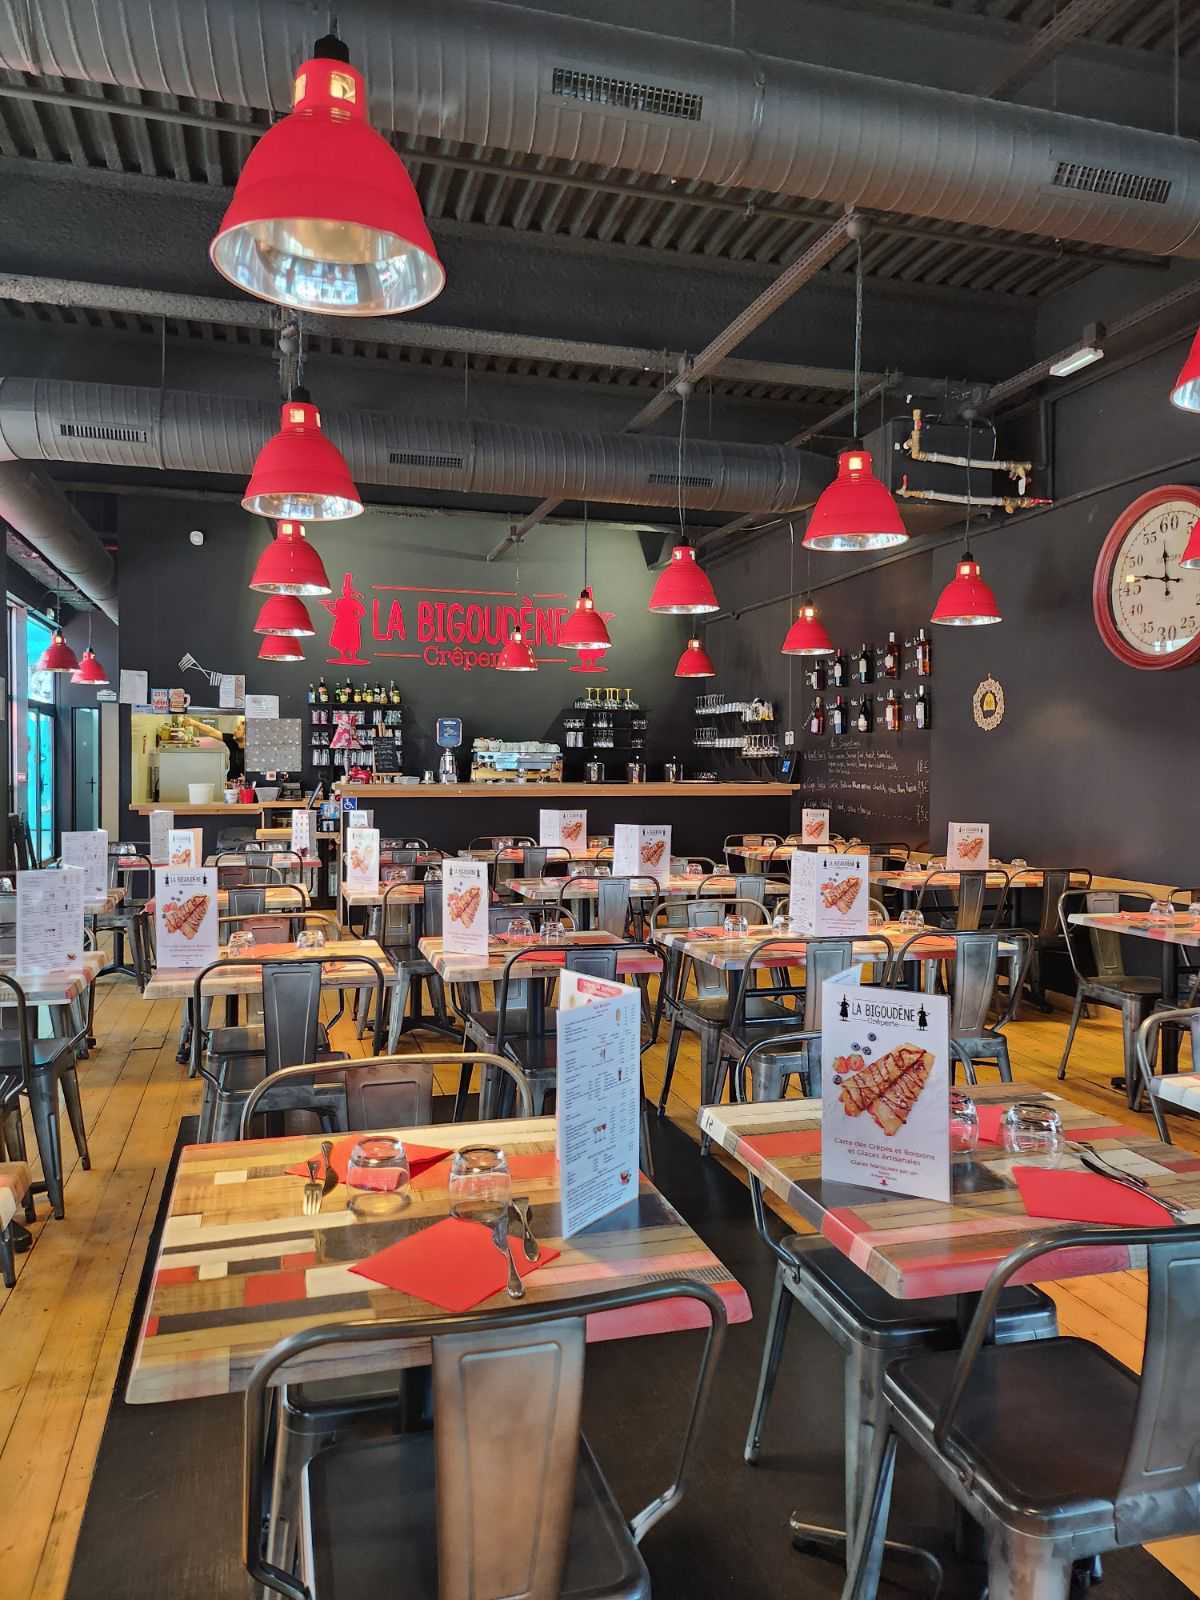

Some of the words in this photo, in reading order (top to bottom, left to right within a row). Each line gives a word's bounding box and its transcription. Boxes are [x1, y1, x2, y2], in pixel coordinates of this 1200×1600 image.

[1160, 514, 1179, 534] 60
[1143, 531, 1157, 545] 55
[1129, 553, 1144, 568] 50
[372, 598, 406, 641] LA
[1180, 615, 1196, 629] 25
[1157, 625, 1177, 642] 30
[852, 1001, 862, 1016] LA
